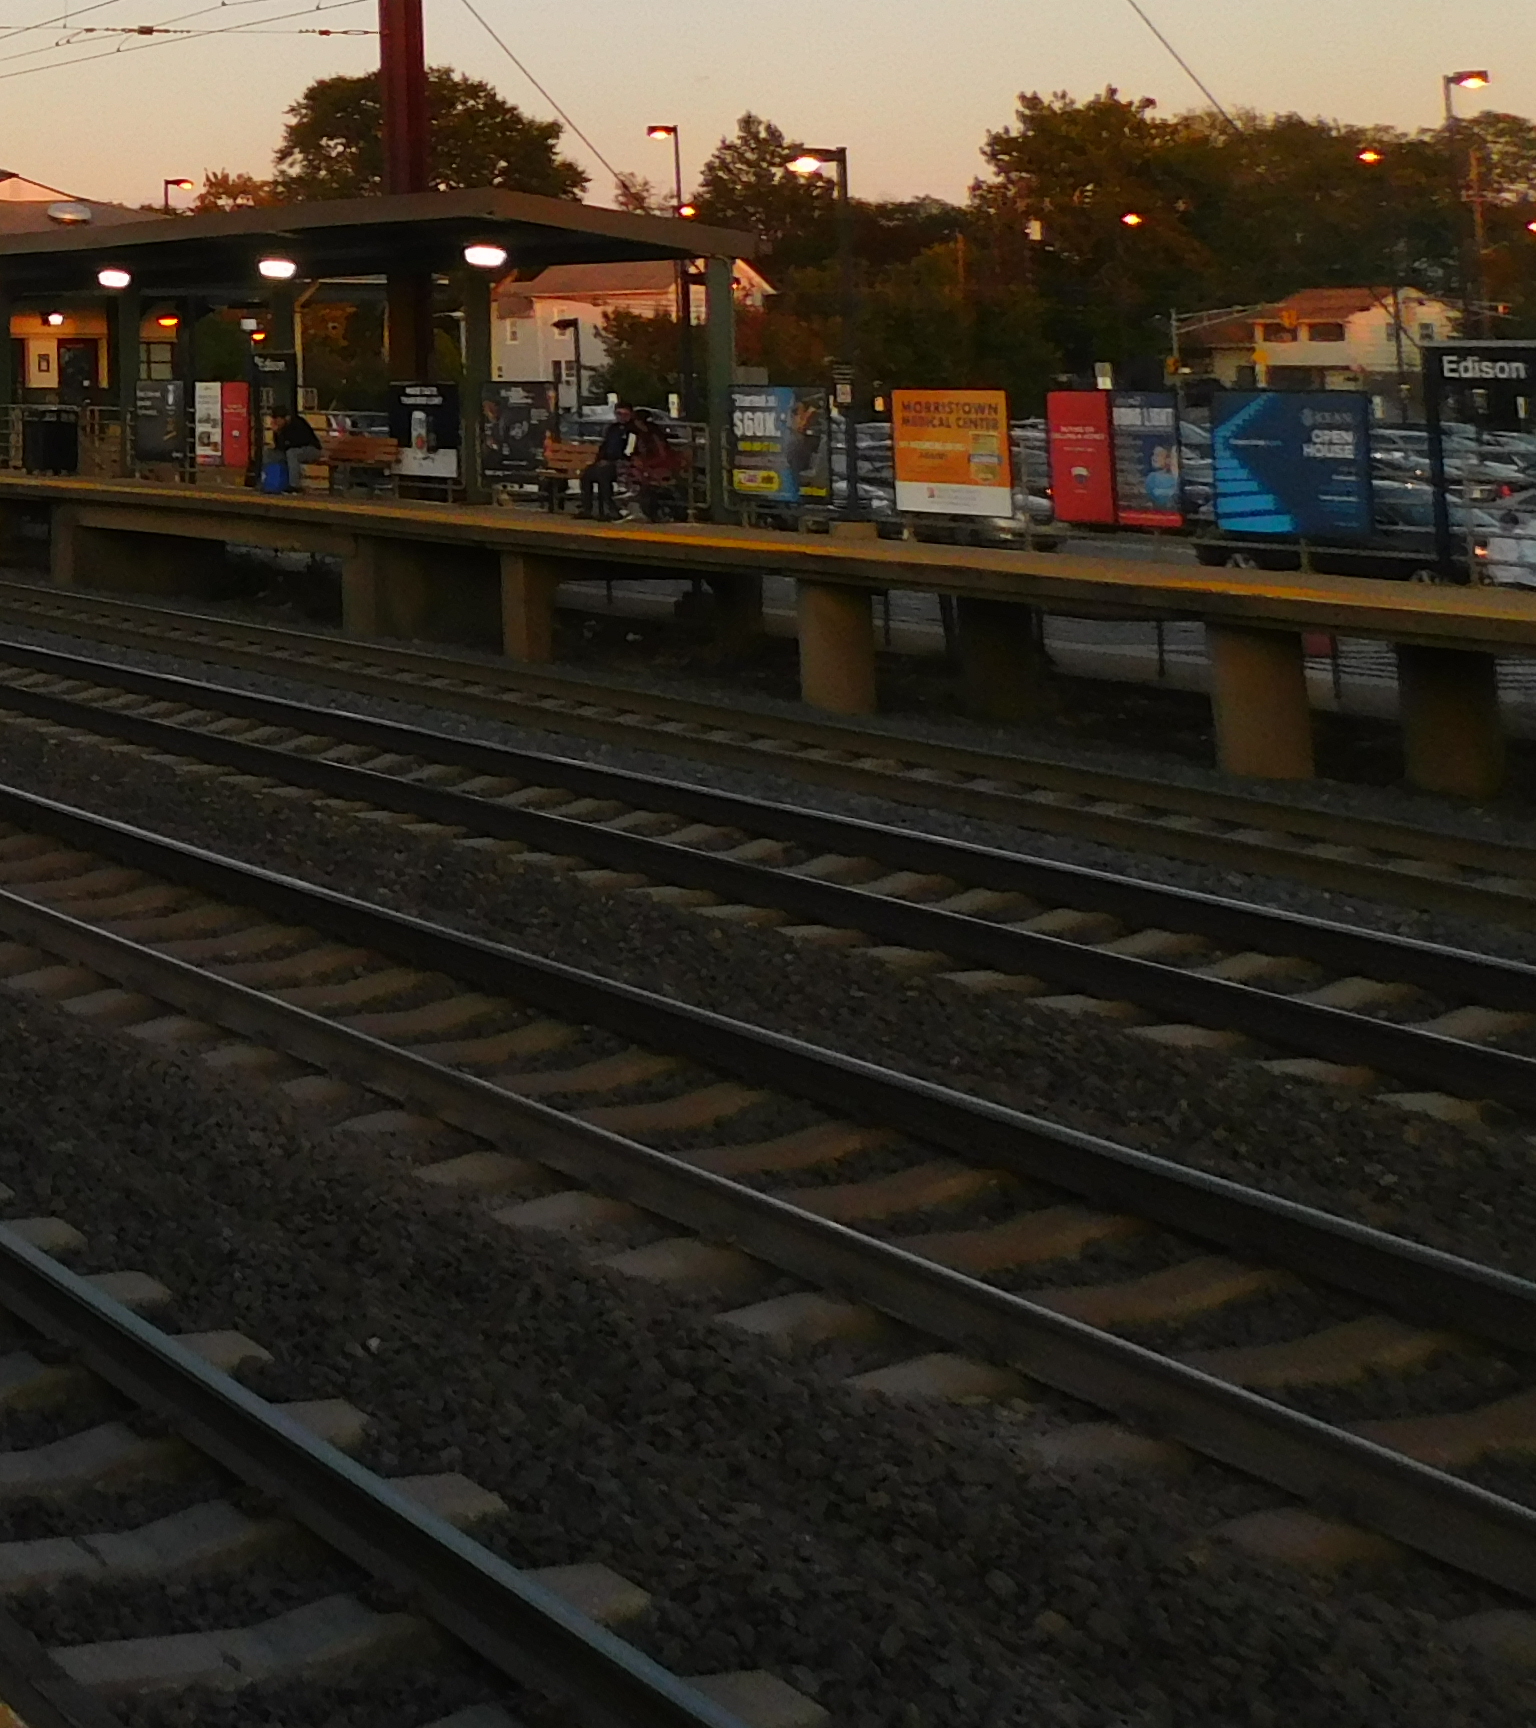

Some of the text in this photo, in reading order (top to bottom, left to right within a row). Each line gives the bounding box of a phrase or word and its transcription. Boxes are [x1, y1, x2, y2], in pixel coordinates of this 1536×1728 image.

[1442, 355, 1528, 379] Edison
[901, 400, 999, 415] MORRISTOWN
[1311, 430, 1354, 443] OPEN
[1302, 443, 1355, 459] HOUSE
